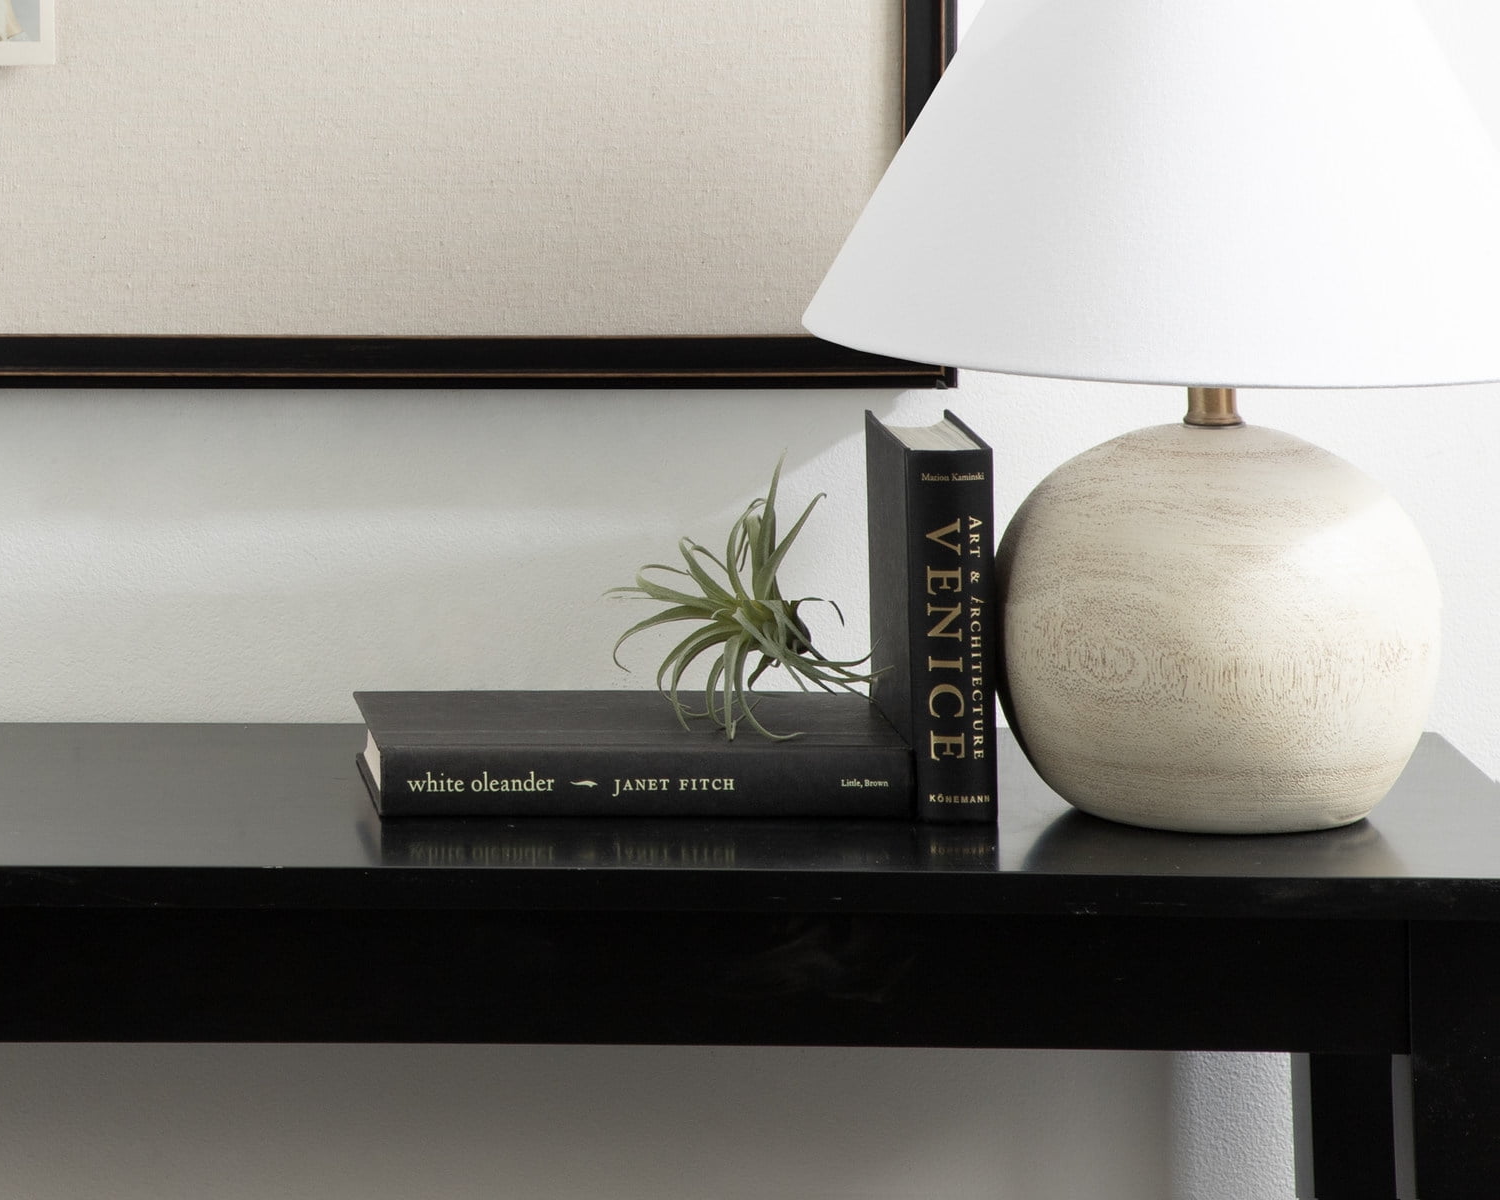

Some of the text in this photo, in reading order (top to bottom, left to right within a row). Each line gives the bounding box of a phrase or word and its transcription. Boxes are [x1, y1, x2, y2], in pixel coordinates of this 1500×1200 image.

[921, 471, 985, 481] Marion Kaminski
[968, 515, 982, 557] ART
[970, 570, 982, 583] &
[925, 518, 965, 761] VENICE
[406, 770, 736, 796] white oleander JANET FITCH
[864, 778, 889, 788] Brown
